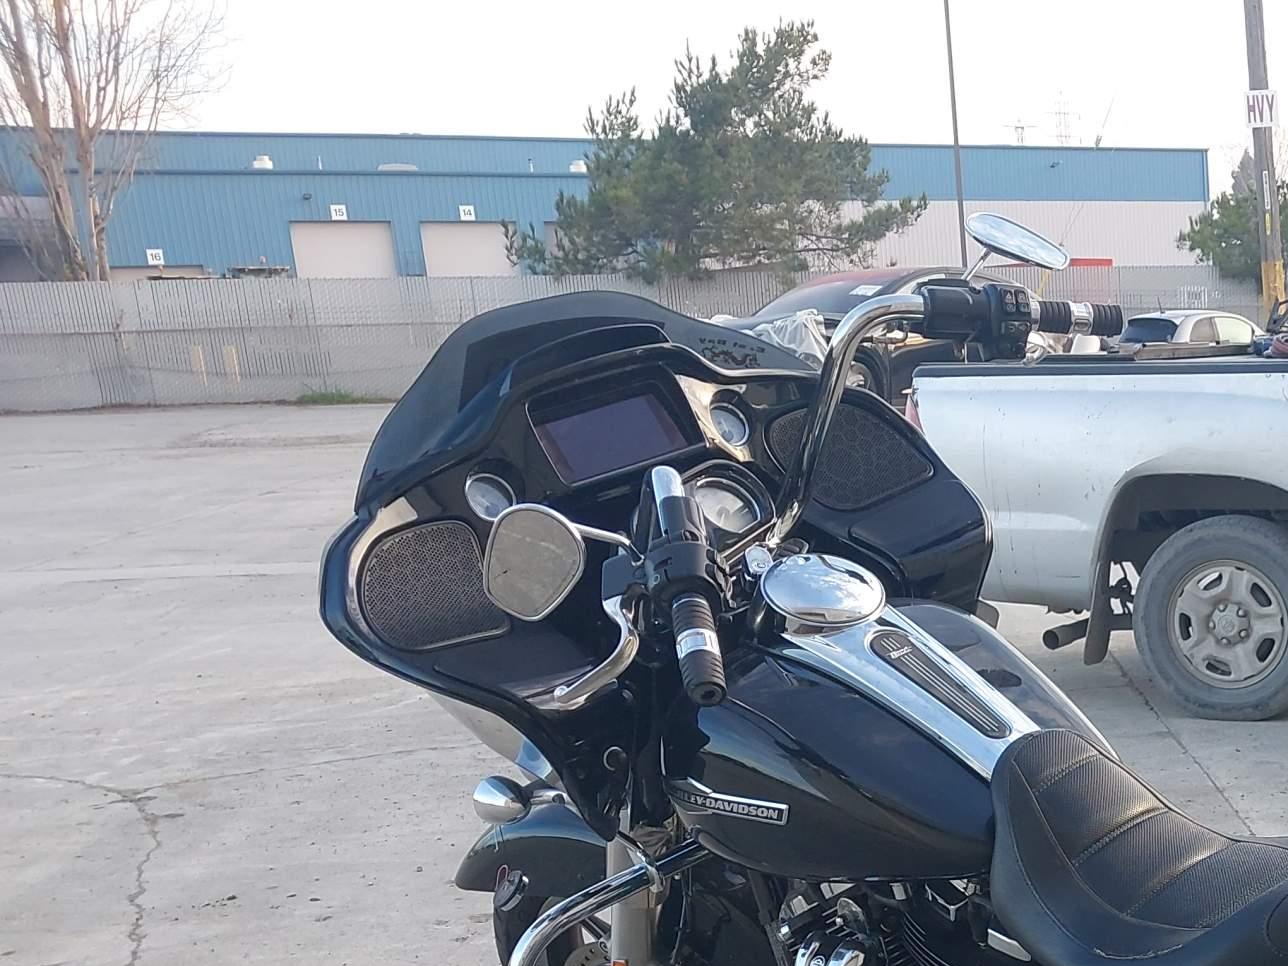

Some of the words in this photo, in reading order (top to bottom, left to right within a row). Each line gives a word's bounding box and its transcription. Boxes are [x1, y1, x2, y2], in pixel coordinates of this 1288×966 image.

[1246, 94, 1274, 123] HVY
[333, 207, 345, 217] 15
[463, 208, 473, 216] 14
[149, 252, 161, 261] 16
